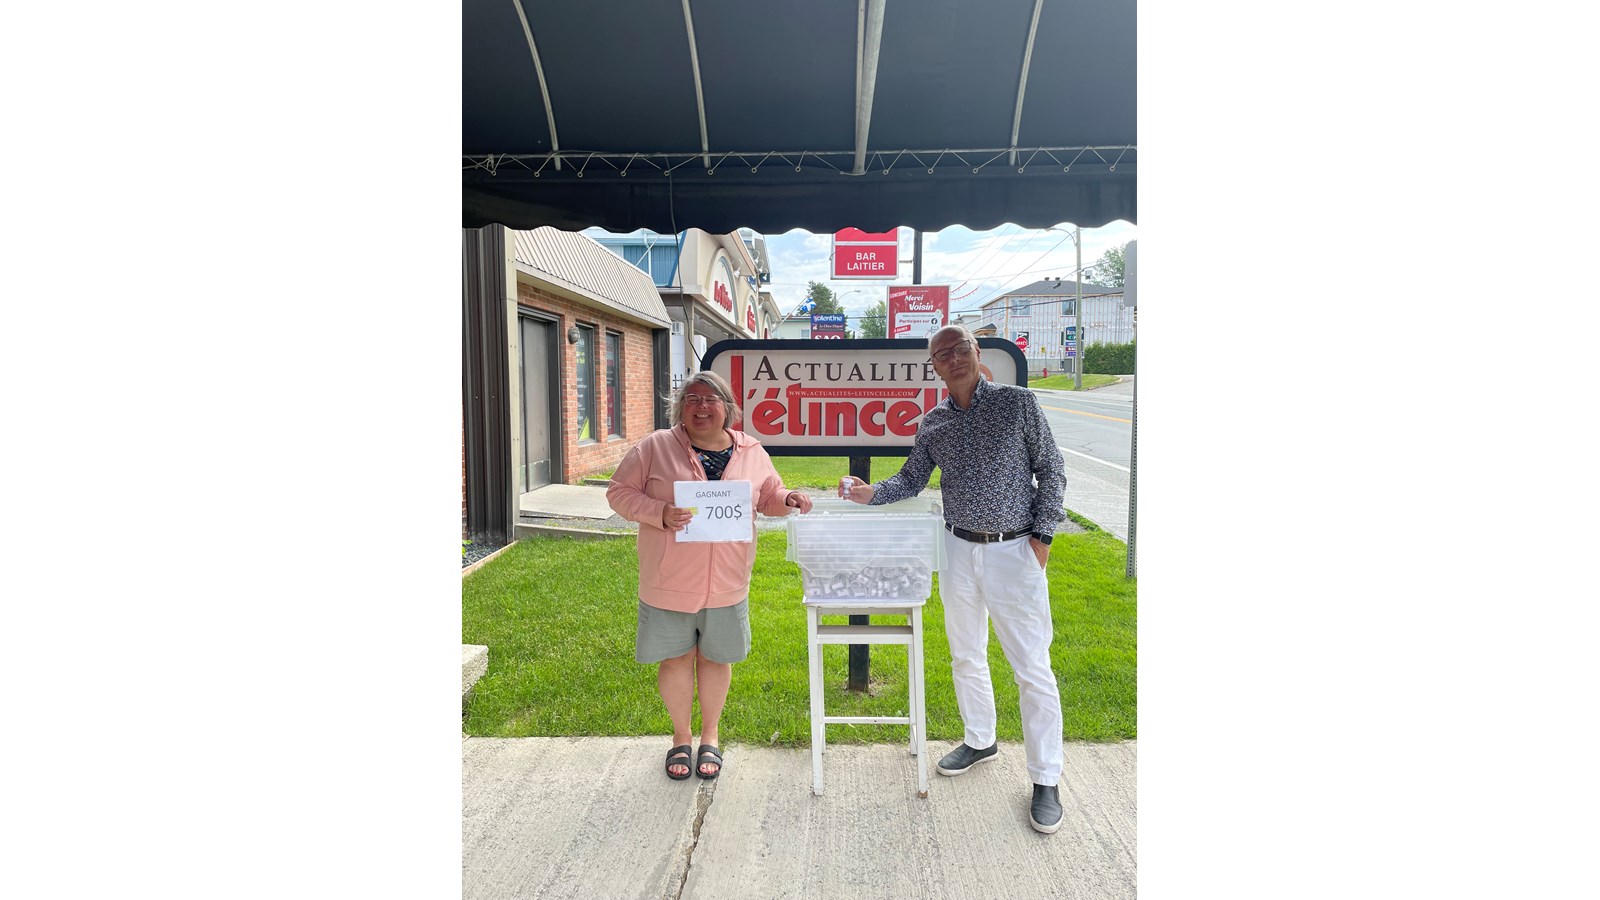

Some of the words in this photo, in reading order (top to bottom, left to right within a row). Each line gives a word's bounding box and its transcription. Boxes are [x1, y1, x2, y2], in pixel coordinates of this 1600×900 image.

[856, 252, 876, 260] BAR
[847, 262, 885, 270] LAITIER
[909, 301, 933, 310] Voisin
[752, 355, 944, 381] ACTUALITÉ
[789, 389, 914, 397] WWW.ACTUALITES-LETINCELLE.COM
[695, 490, 732, 498] GAGNANT
[706, 503, 743, 520] 700$
